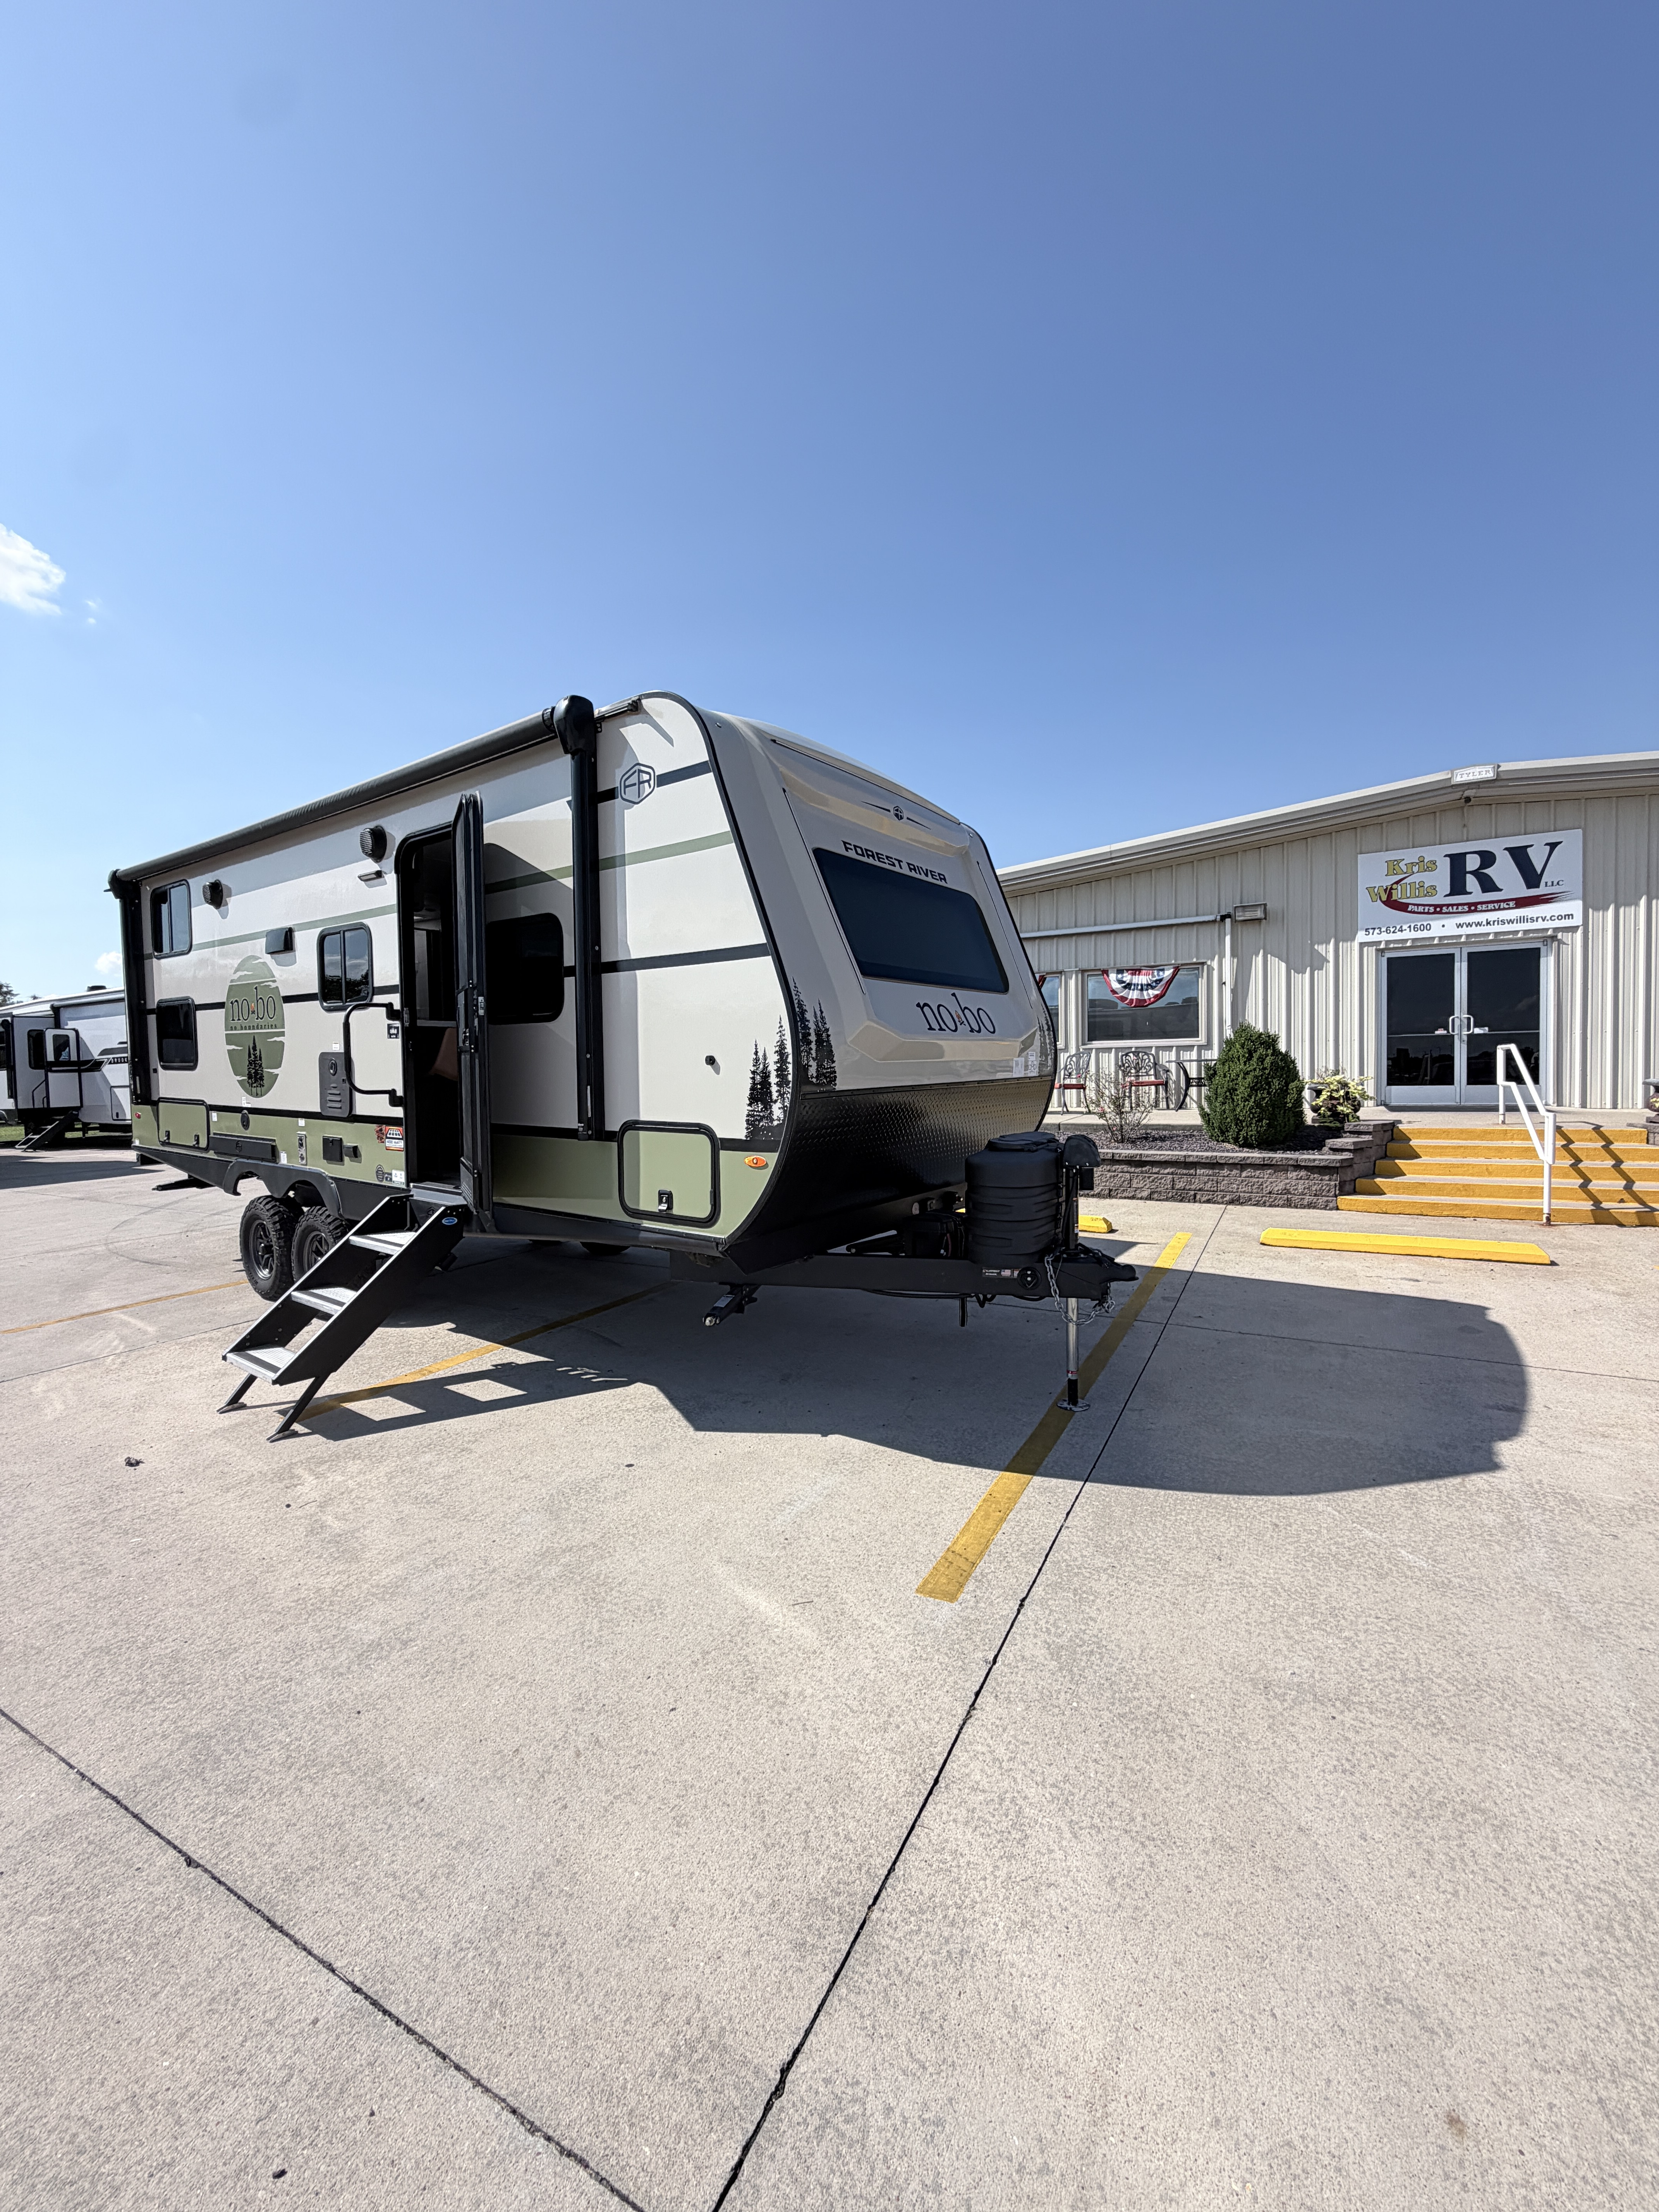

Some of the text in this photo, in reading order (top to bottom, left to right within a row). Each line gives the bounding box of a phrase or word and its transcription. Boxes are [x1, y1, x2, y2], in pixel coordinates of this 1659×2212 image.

[1459, 769, 1491, 778] TYLER
[841, 840, 948, 884] FOREST RIVER
[1385, 855, 1437, 876] Kris
[1443, 841, 1563, 897] RV
[1365, 881, 1437, 902] Willis
[1407, 905, 1434, 913] PARTS
[1477, 901, 1516, 910] SERVICE
[1365, 913, 1574, 936] 573-624-1600 www.kriswillisrv.com
[240, 1022, 277, 1030] boundaries
